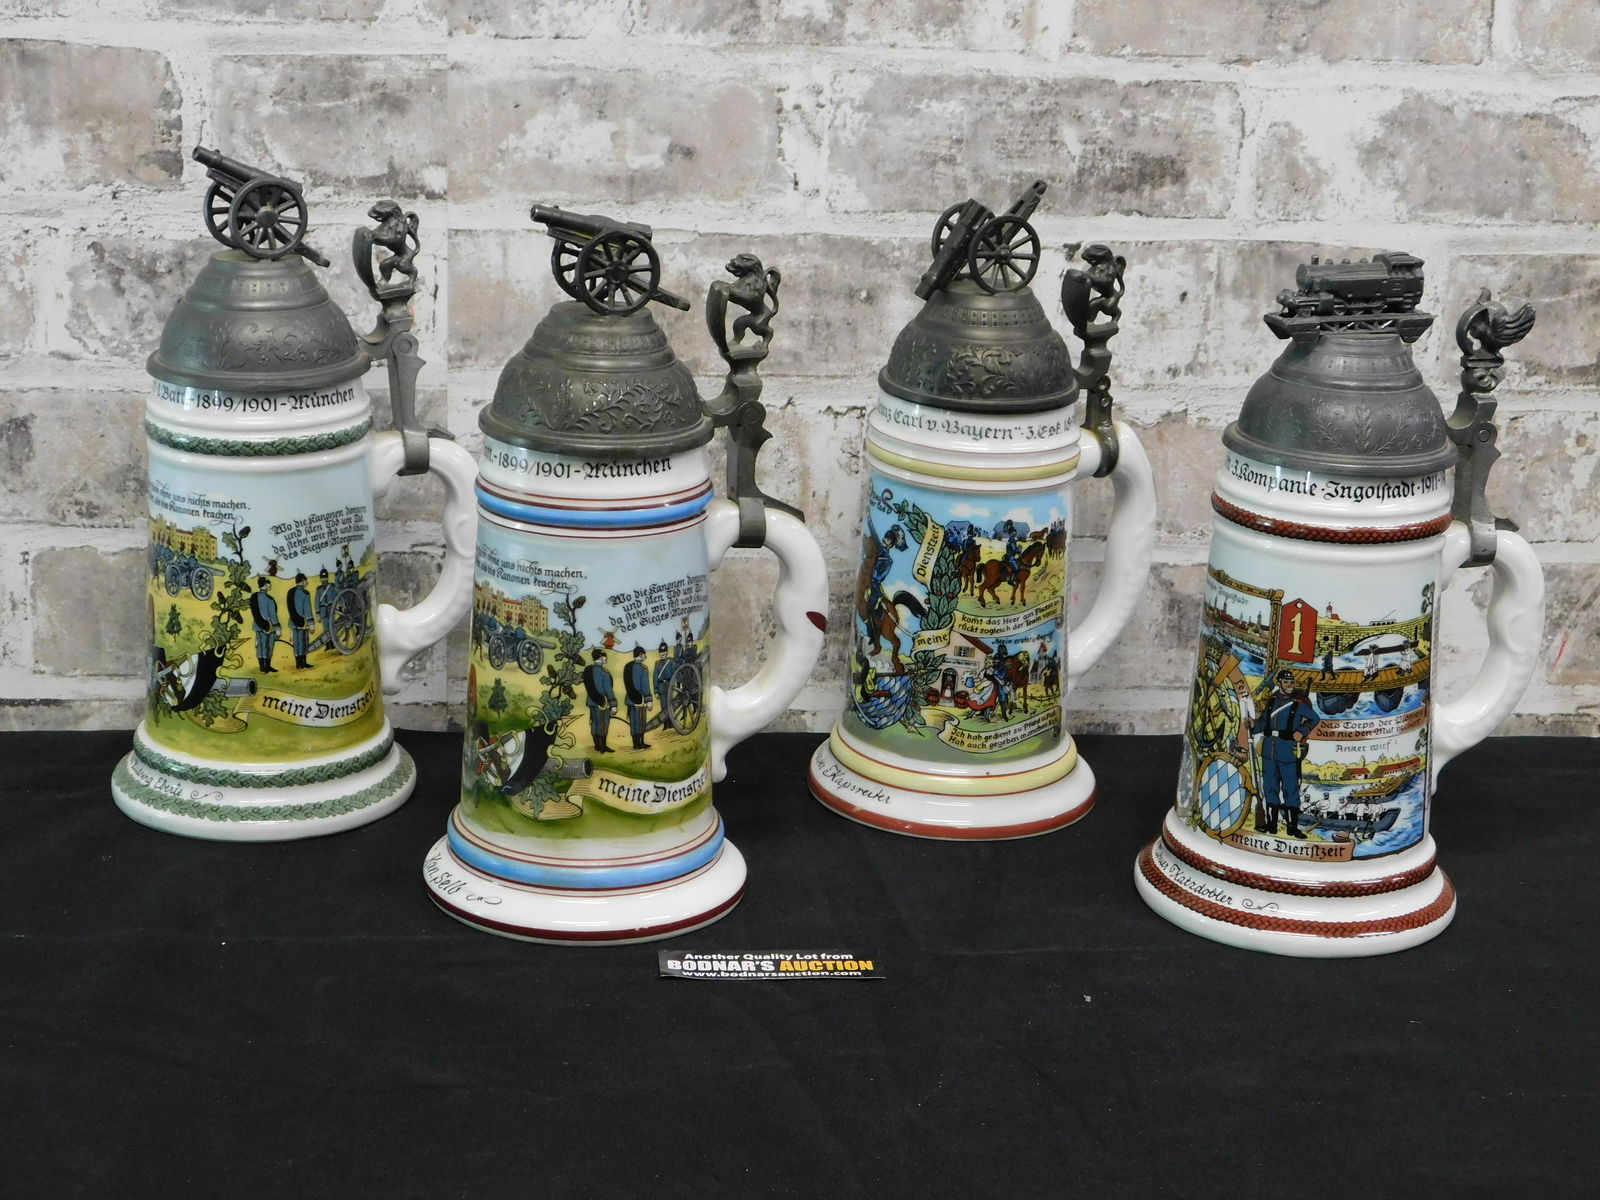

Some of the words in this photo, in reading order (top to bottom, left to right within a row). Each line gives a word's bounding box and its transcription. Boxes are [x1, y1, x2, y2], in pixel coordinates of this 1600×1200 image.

[916, 523, 941, 578] Dienstzeit
[985, 617, 1001, 626] das
[917, 632, 949, 646] meine
[1288, 612, 1303, 656] 1
[262, 695, 312, 719] meine
[1315, 730, 1336, 738] das
[1354, 730, 1372, 738] den
[598, 777, 650, 804] meine
[1231, 832, 1271, 852] meine
[742, 953, 794, 961] Quality
[667, 960, 775, 971] BODNAR'S
[779, 960, 875, 971] AUCTION
[681, 970, 862, 978] www.bodnarsauction.com
